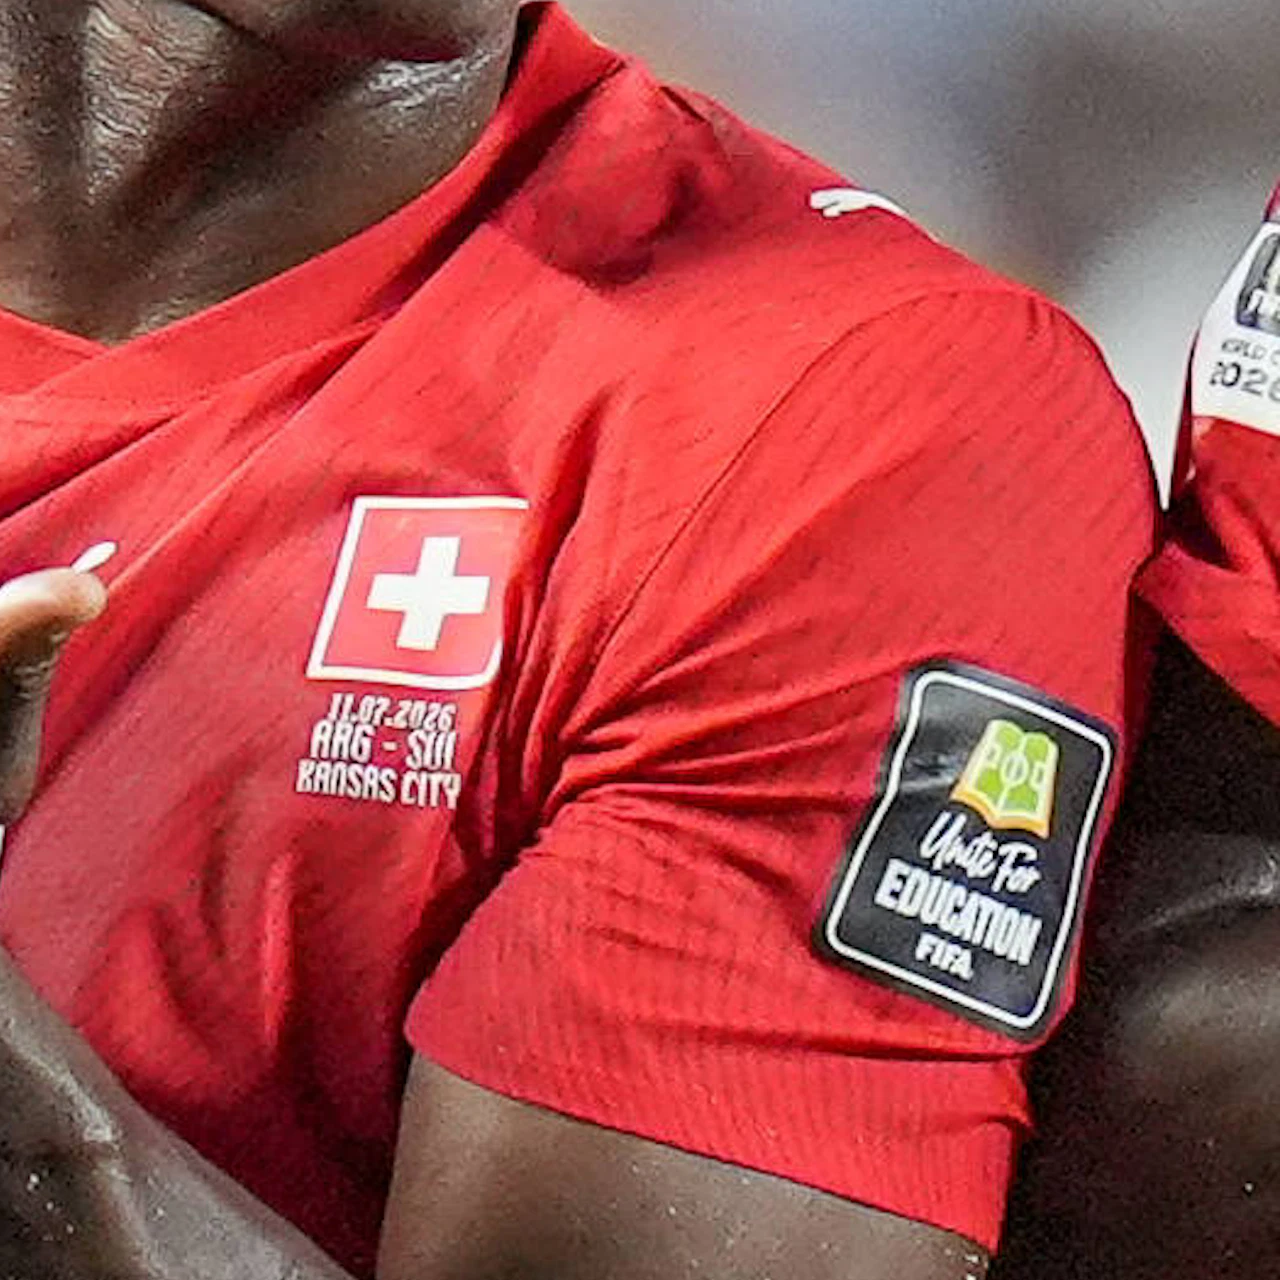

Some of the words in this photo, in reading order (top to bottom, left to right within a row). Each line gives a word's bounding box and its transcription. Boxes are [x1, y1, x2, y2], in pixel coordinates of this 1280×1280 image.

[327, 693, 456, 732] 11.07.2026
[310, 720, 375, 763] ARG
[405, 729, 457, 771] SUI
[296, 758, 398, 803] KANSAS
[400, 770, 462, 810] CITY
[919, 810, 999, 880] Unite
[990, 840, 1041, 894] For
[874, 857, 1043, 966] EDUCATION
[915, 932, 974, 981] FIFA
